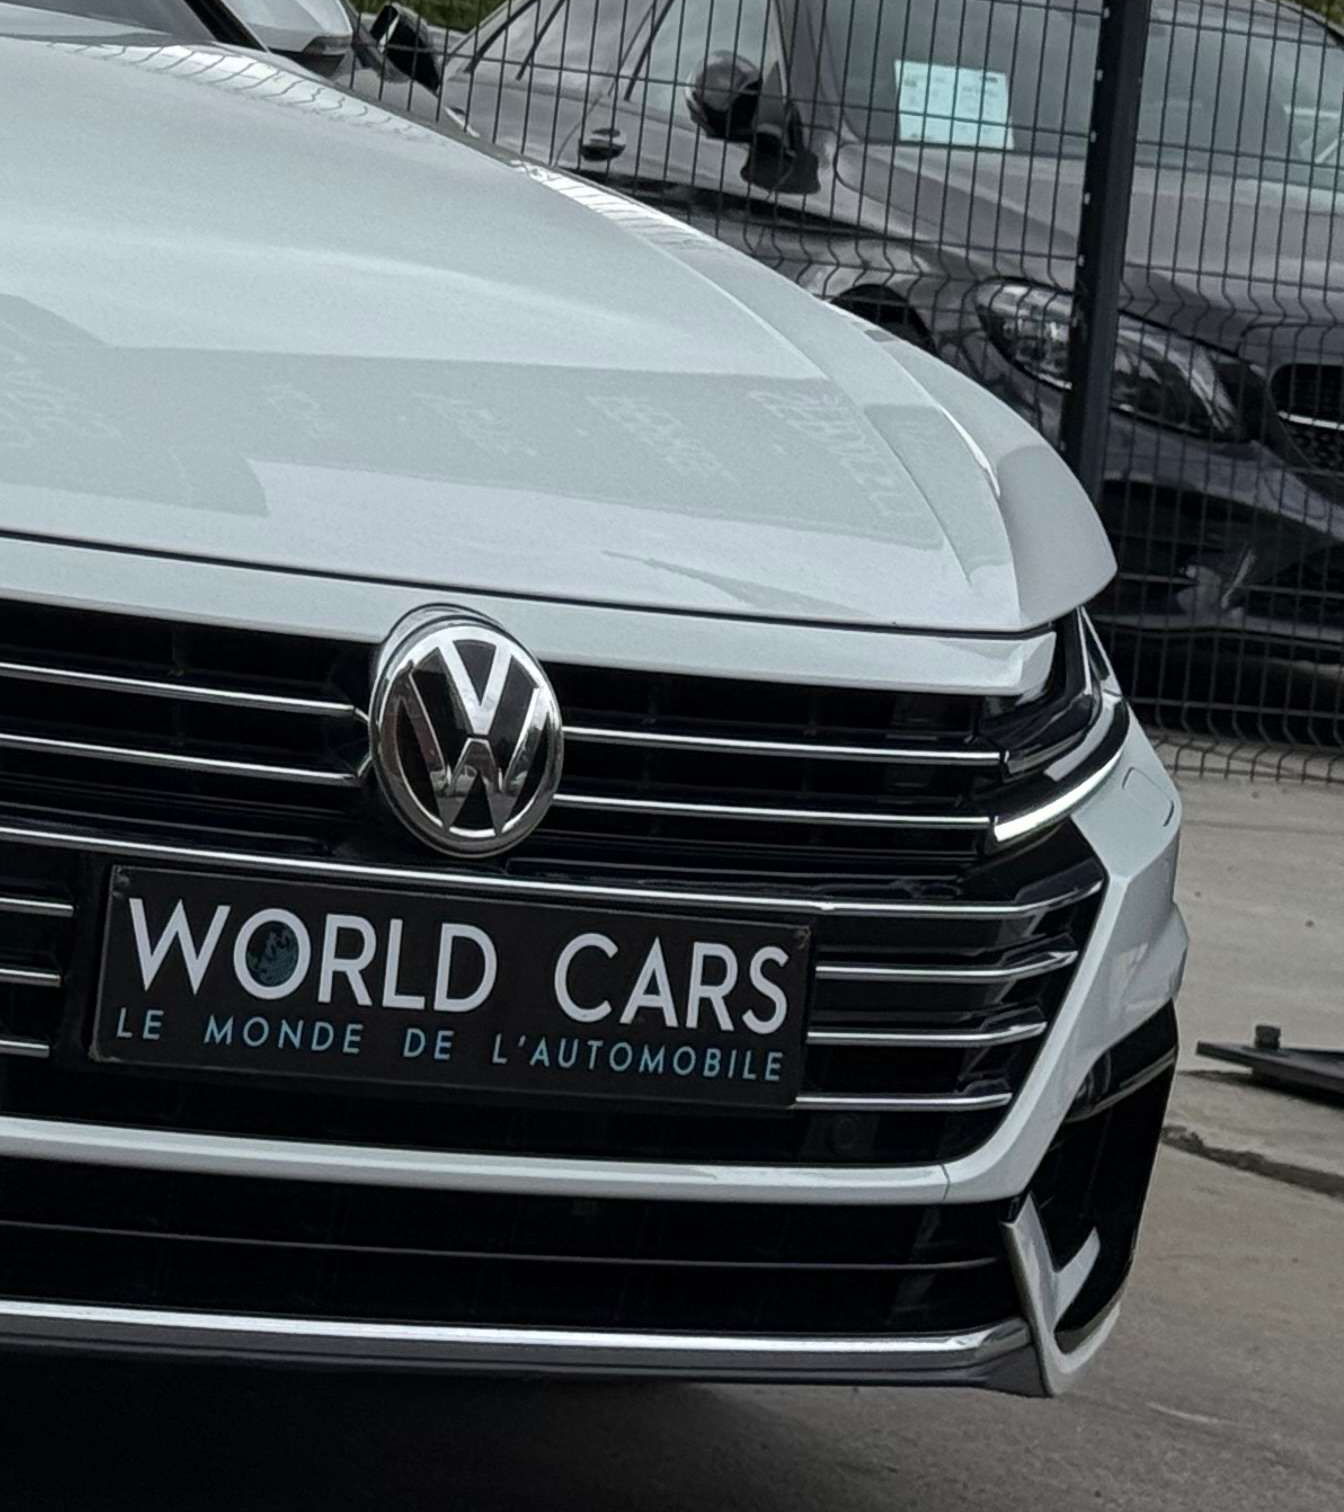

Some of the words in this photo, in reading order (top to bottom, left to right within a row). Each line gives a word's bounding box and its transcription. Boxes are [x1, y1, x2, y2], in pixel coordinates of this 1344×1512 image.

[374, 623, 561, 844] VW
[128, 897, 498, 1013] WORLD
[554, 932, 790, 1035] CARS
[116, 1007, 164, 1040] LE
[204, 1015, 364, 1055] MONDE
[403, 1028, 455, 1061] DE
[492, 1033, 784, 1081] L'AUTOMOBILE
